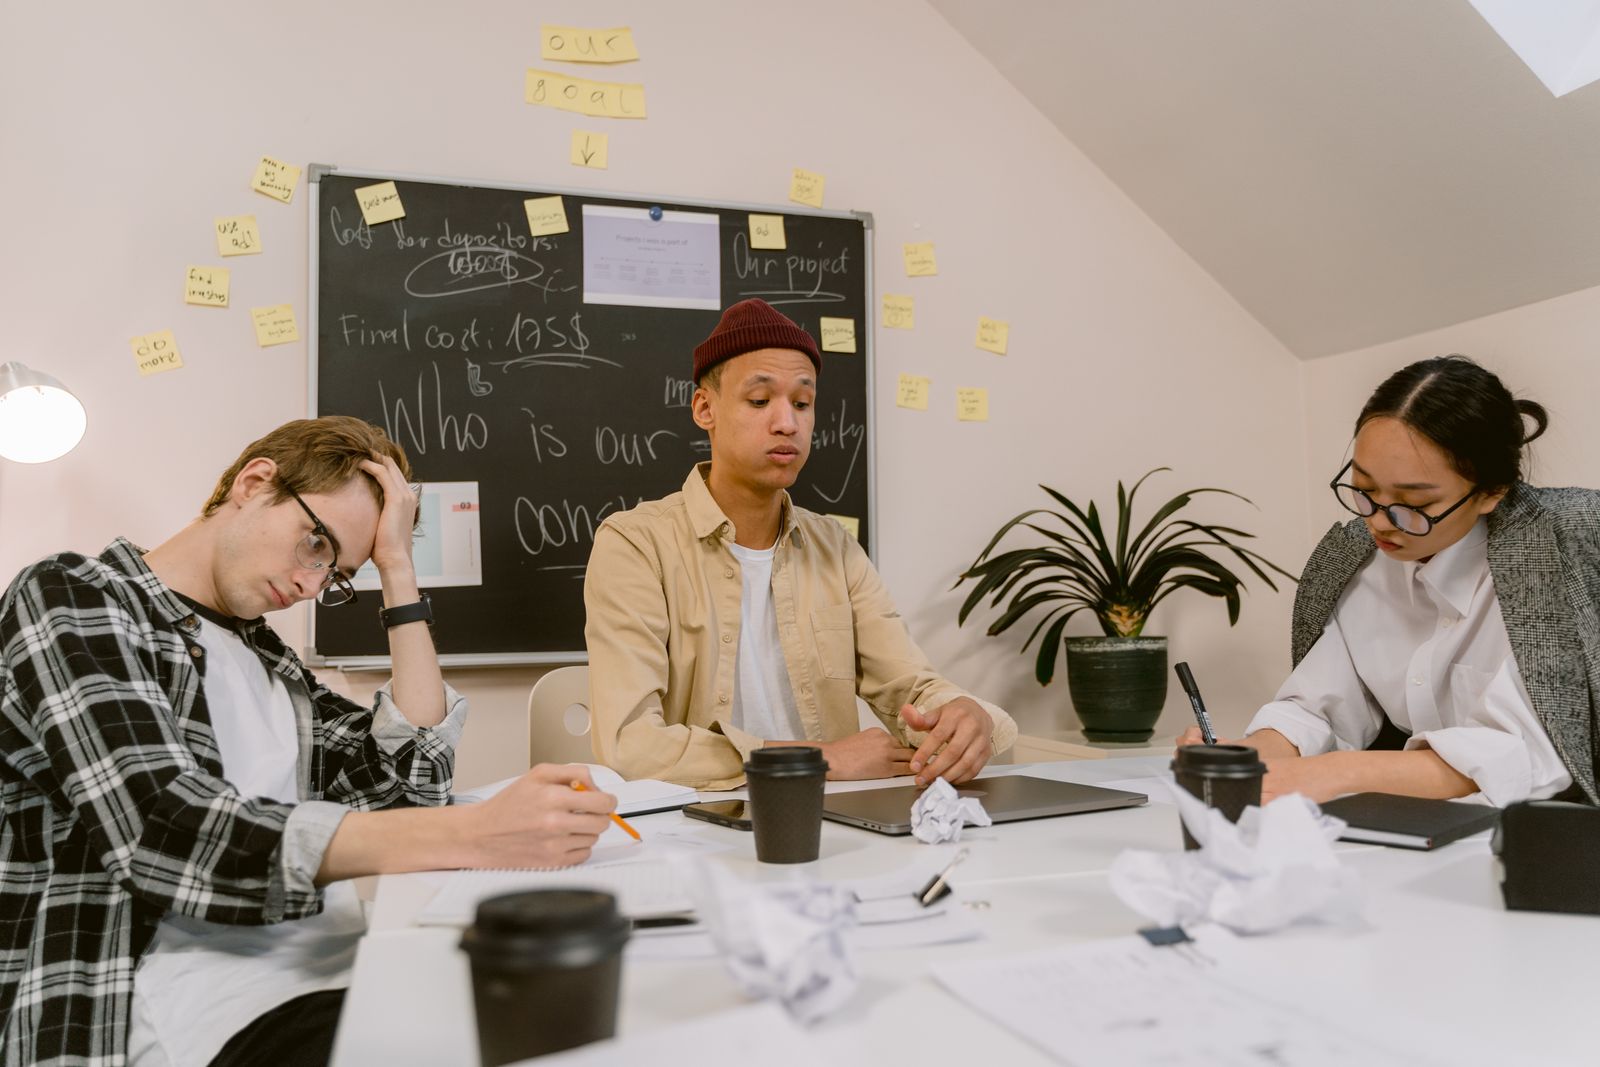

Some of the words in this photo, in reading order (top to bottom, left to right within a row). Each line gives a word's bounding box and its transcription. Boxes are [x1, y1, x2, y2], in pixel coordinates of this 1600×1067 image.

[549, 34, 619, 56] our
[785, 241, 850, 298] project
[339, 308, 410, 351] Final
[137, 336, 167, 357] do
[140, 351, 177, 370] more
[378, 361, 488, 455] Who
[521, 407, 567, 463] is
